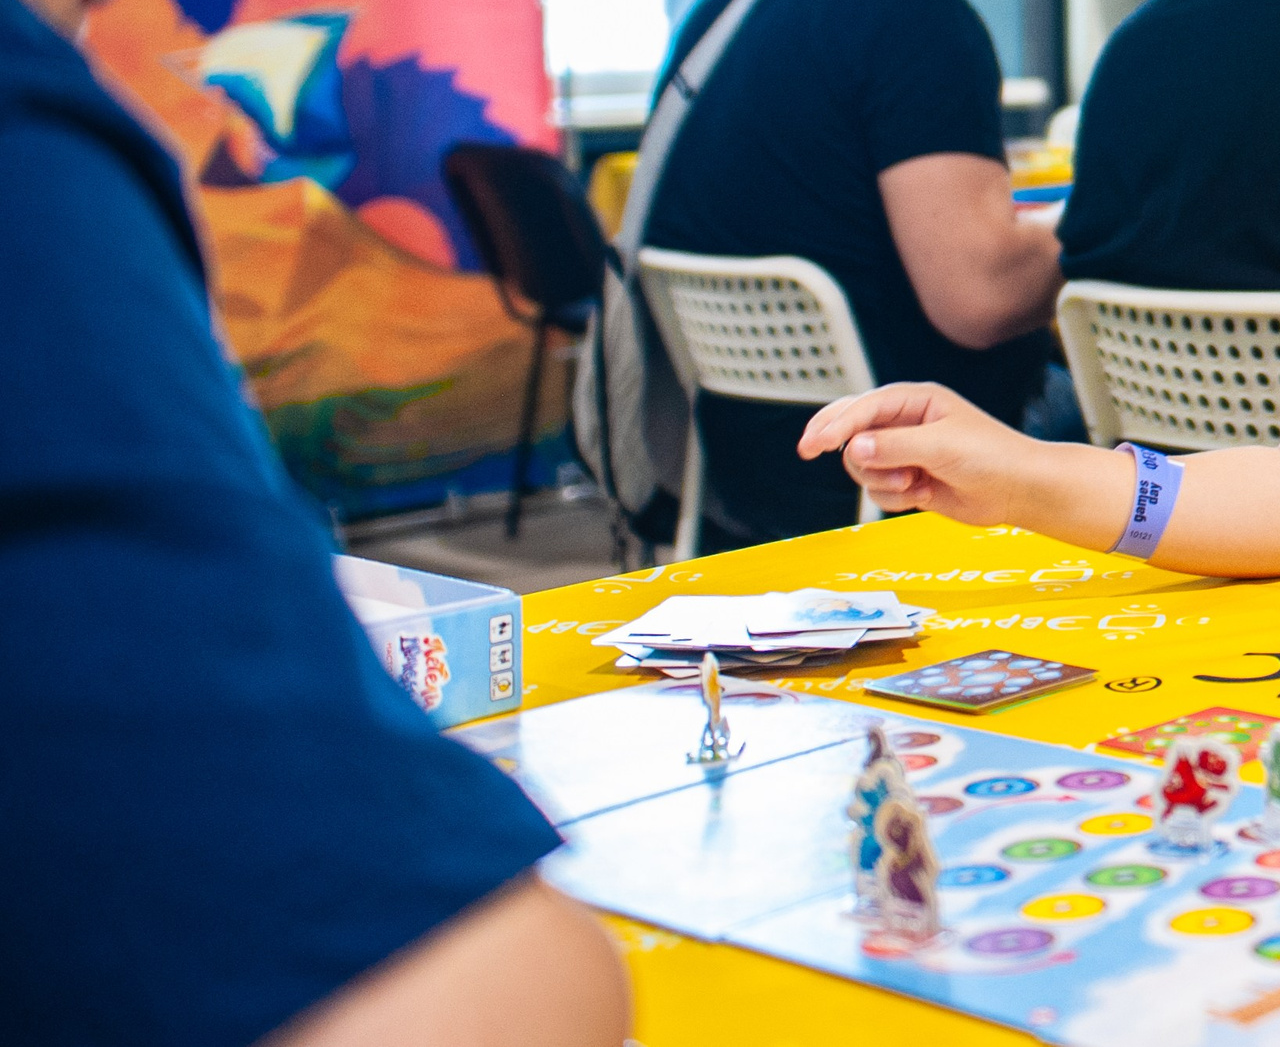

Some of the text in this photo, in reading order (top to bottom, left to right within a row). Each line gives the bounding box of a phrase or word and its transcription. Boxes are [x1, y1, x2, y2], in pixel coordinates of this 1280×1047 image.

[1134, 479, 1150, 523] games
[1149, 481, 1163, 505] day
[1130, 530, 1153, 541] 10121
